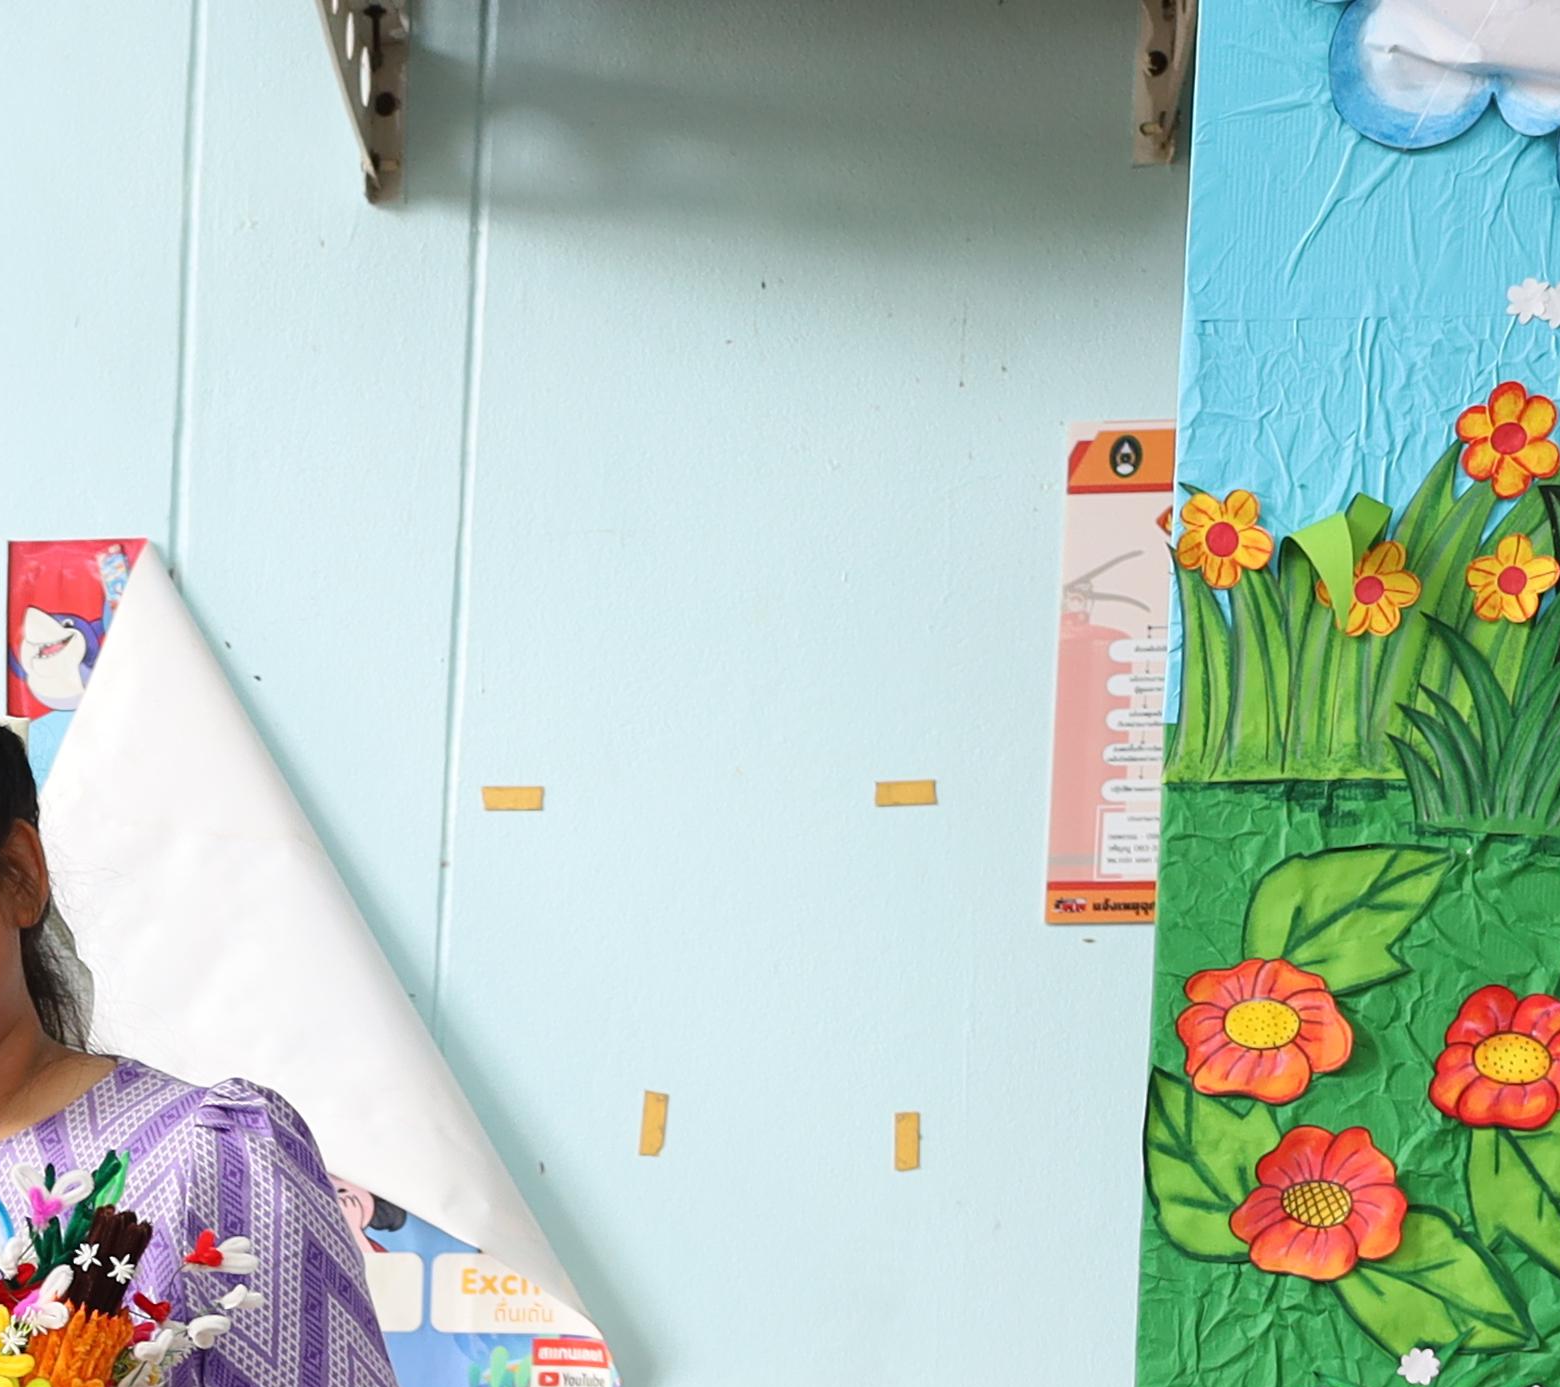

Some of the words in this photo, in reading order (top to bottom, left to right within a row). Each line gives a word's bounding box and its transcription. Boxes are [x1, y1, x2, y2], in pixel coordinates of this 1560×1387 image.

[494, 1298, 555, 1323] ตื่นเต้น
[562, 1372, 606, 1387] YouTube
